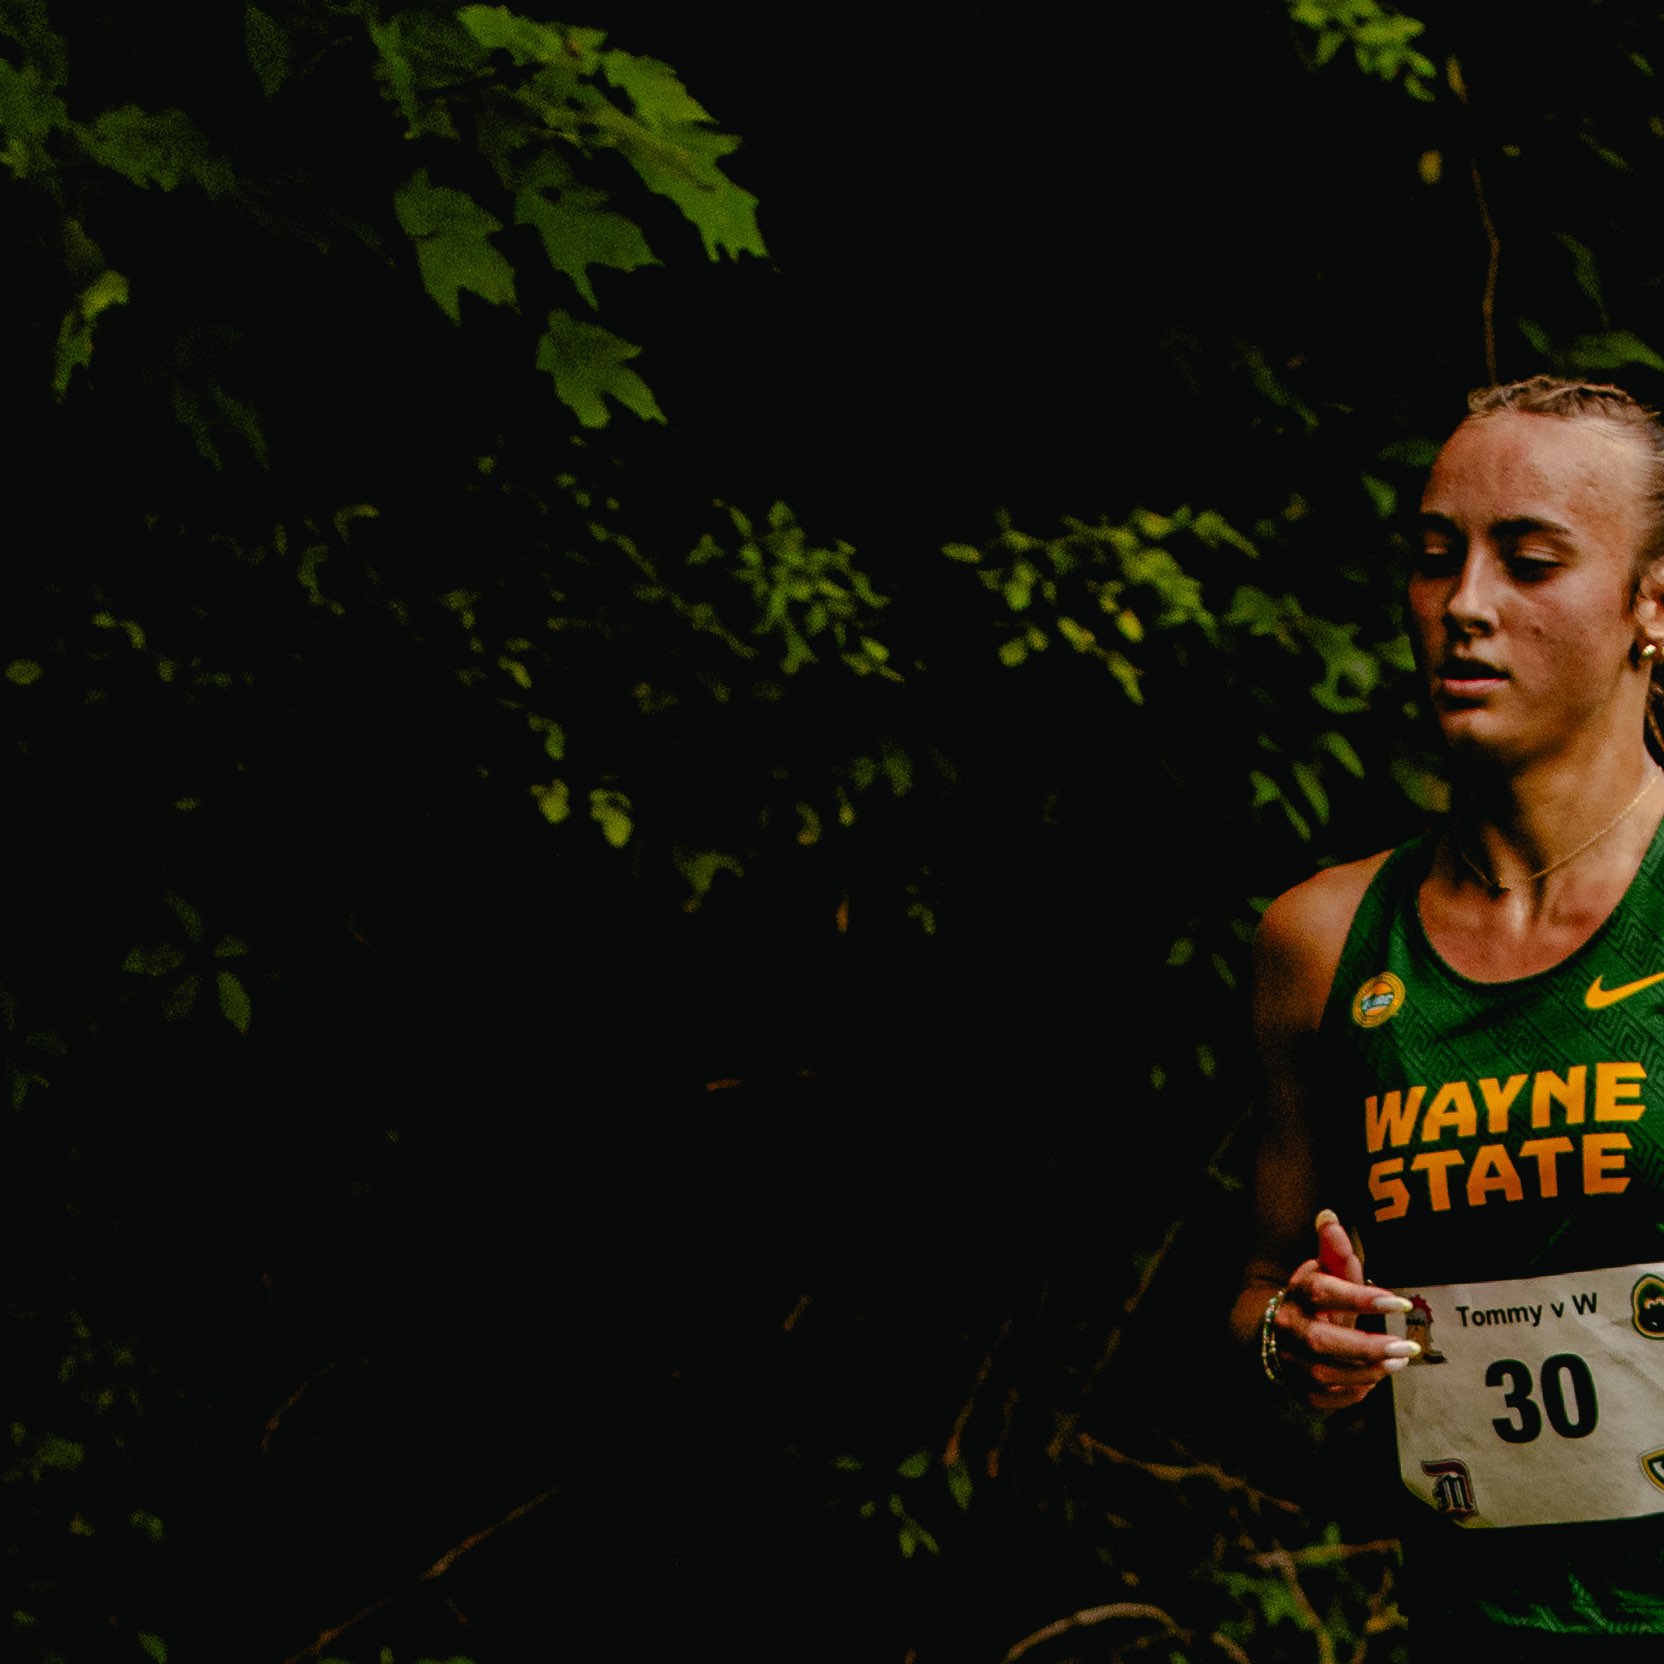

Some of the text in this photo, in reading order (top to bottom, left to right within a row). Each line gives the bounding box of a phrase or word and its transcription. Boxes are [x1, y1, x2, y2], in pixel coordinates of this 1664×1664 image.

[1365, 1061, 1647, 1153] WAYNE
[1368, 1132, 1633, 1222] STATE
[1456, 1292, 1598, 1328] Tommy v W
[1485, 1352, 1599, 1444] 30
